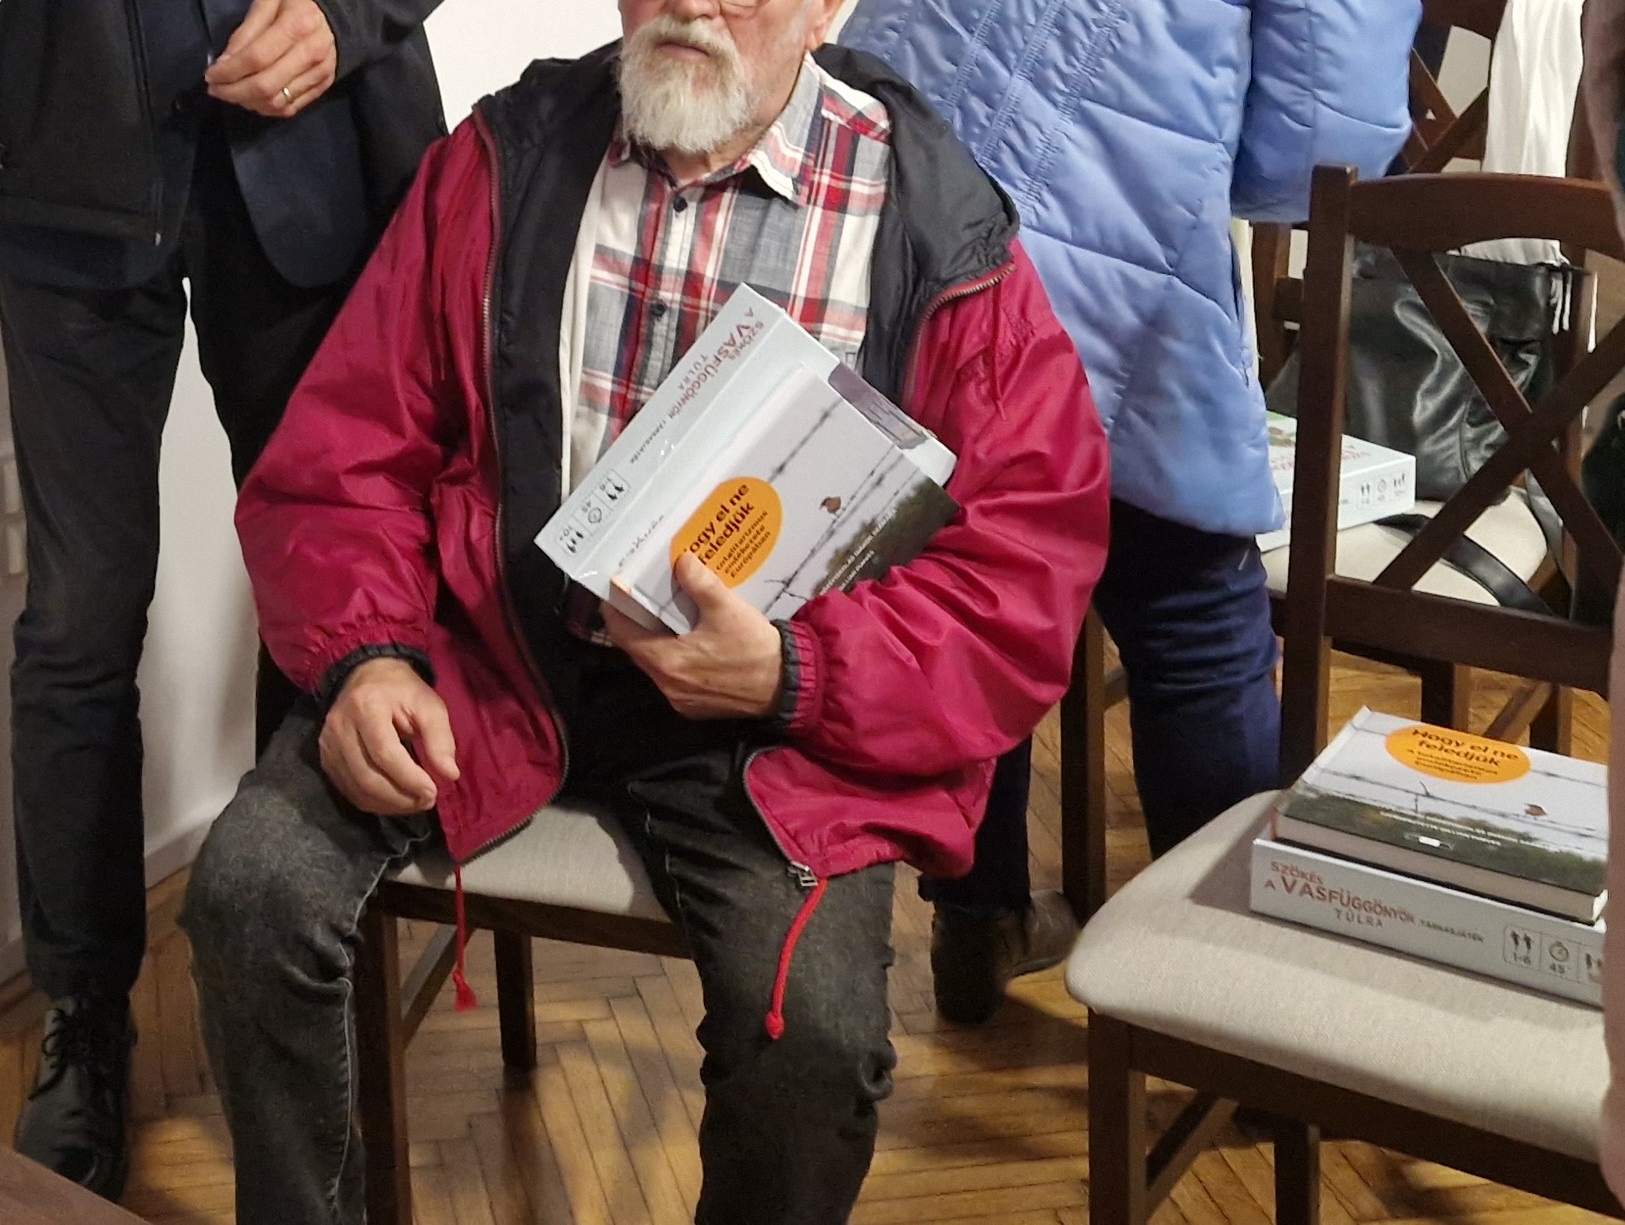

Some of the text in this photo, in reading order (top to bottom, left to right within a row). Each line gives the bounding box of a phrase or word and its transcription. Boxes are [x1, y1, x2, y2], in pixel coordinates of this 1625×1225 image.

[683, 484, 749, 554] ogy el ne
[1264, 879, 1276, 890] A
